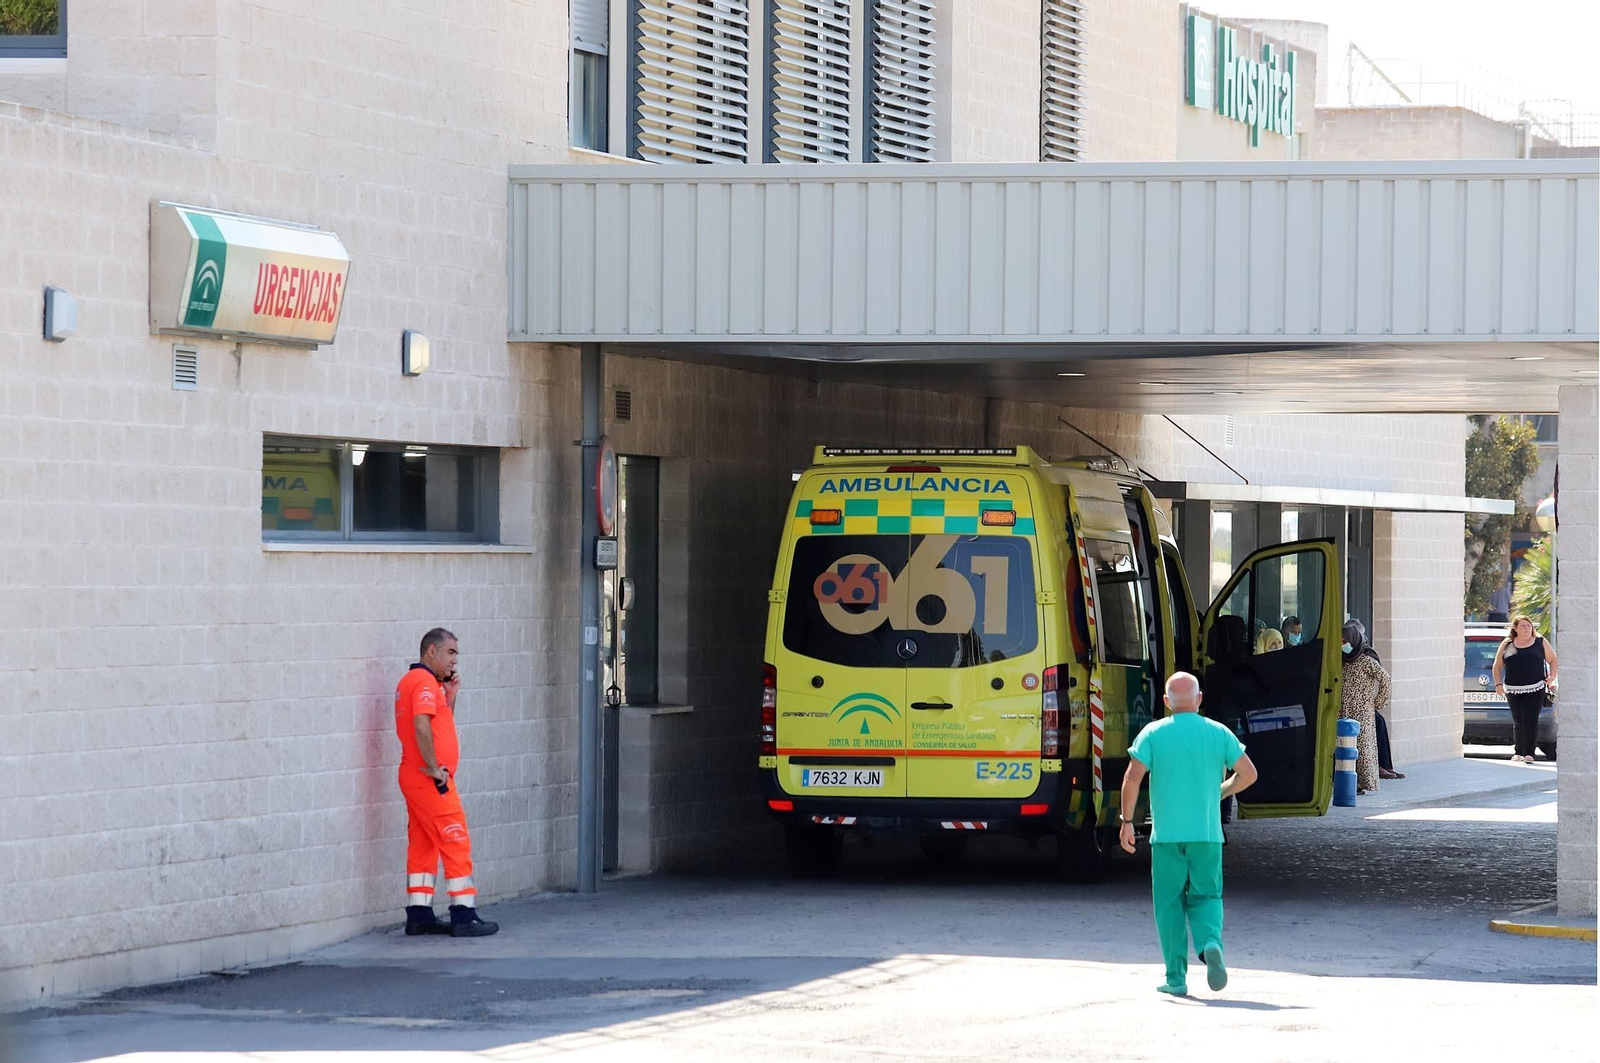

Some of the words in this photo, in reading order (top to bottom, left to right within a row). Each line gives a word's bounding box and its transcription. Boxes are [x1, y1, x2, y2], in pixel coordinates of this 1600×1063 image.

[1218, 26, 1297, 147] Hospital
[253, 262, 342, 323] URGENCIAS
[819, 477, 1011, 494] AMBULANCIA
[813, 563, 888, 605] 061
[818, 535, 1009, 636] 061
[1466, 693, 1488, 701] 8560
[911, 722, 940, 730] Empresa
[827, 738, 850, 747] JUNTA
[853, 739, 862, 747] DE
[922, 732, 964, 740] Emergencias
[813, 771, 848, 785] 7632
[854, 771, 881, 785] KJN
[976, 762, 1033, 780] E-225
